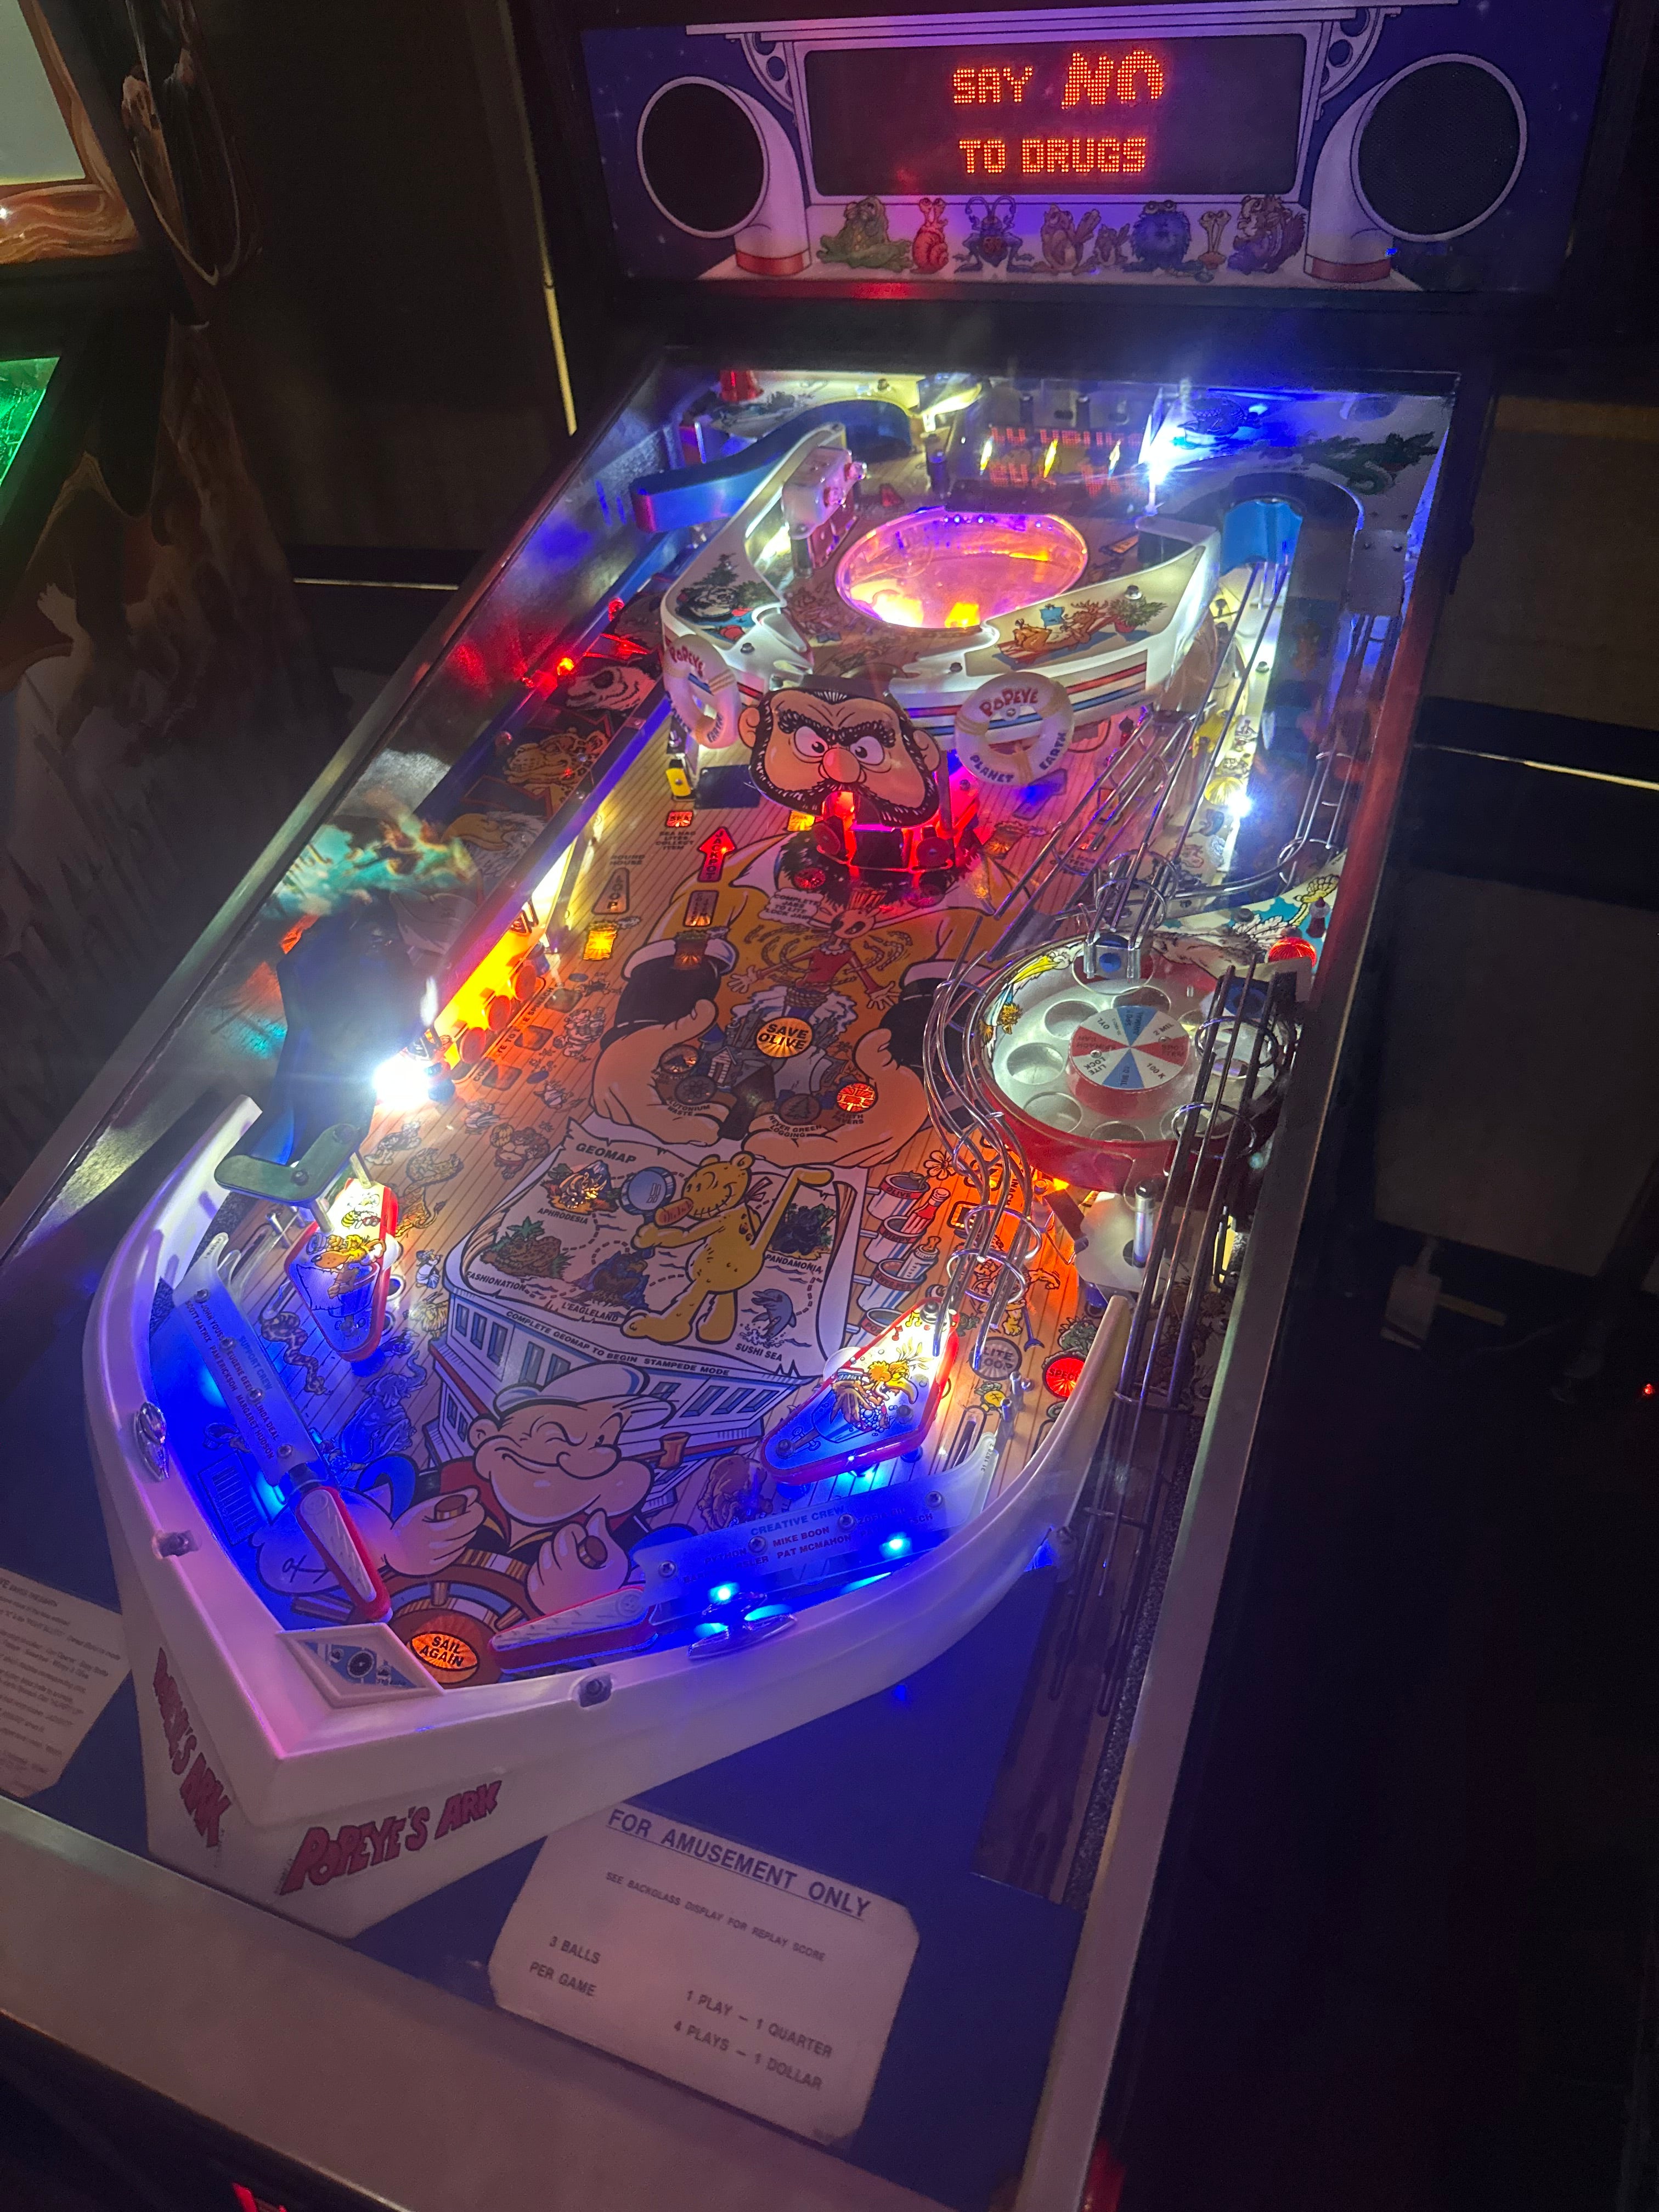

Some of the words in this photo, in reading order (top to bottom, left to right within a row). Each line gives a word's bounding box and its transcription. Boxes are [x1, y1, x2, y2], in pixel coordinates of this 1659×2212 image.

[953, 66, 1033, 104] SAY
[1061, 50, 1164, 110] NO
[959, 138, 1006, 173] TO
[1022, 137, 1147, 173] DRUGS
[669, 646, 704, 677] POPEYE
[979, 687, 1038, 716] POPEYE
[969, 754, 1014, 783] PLANET
[1039, 732, 1066, 770] EARTH
[706, 831, 724, 879] JACKPOT
[774, 894, 821, 905] COMPLETE
[766, 1023, 809, 1039] SAVE
[1097, 1018, 1110, 1030] OYL
[505, 1032, 516, 1043] TO
[758, 1034, 807, 1050] OLIVE
[1084, 1057, 1106, 1070] LOCK
[1088, 1064, 1107, 1075] LITE
[1147, 1063, 1160, 1074] 100
[667, 1107, 693, 1116] WASTE
[769, 1115, 791, 1131] NEVER
[792, 1125, 822, 1133] GREEN
[770, 1125, 805, 1138] LOGGING
[575, 1142, 637, 1164] GEOMAP
[885, 1186, 912, 1199] OLIVE
[537, 1207, 589, 1224] APHRODESIA
[764, 1254, 822, 1274] PANDAMONIA
[466, 1271, 527, 1291] FASHIONATION
[561, 1302, 619, 1323] L'EAGLELAND
[506, 1310, 551, 1335] COMPLETE
[553, 1331, 590, 1350] GEOMAP
[592, 1347, 605, 1356] TO
[606, 1350, 638, 1363] BEGIN
[644, 1357, 697, 1372] STAMPEDE
[699, 1364, 730, 1376] MODE
[735, 1343, 764, 1356] SUSHI
[764, 1351, 782, 1361] SEA
[983, 1347, 1013, 1361] LITE
[200, 1304, 214, 1322] JOHN
[211, 1320, 225, 1341] YOUSS
[227, 1351, 245, 1377] EUGENE
[255, 1400, 270, 1422] LINDA
[266, 1420, 280, 1441] DEAL
[240, 1335, 259, 1369] SUPPORT
[257, 1367, 273, 1391] CREW
[984, 1359, 1013, 1369] OOP
[185, 1300, 199, 1319] SCOTT
[195, 1318, 212, 1343] MATRIX
[217, 1358, 238, 1392] ERICKSON
[236, 1394, 259, 1429] MARGARET
[255, 1428, 274, 1459] HUDSON
[1048, 1368, 1079, 1381] SPECI
[750, 1515, 809, 1536] CREATIVE
[811, 1505, 845, 1521] CREW
[772, 1534, 799, 1548] MIKE
[800, 1526, 831, 1541] BOON
[777, 1548, 798, 1560] PAT
[799, 1534, 852, 1553] MCMAHON
[419, 1645, 464, 1667] AGAIN
[431, 1635, 461, 1655] SAIL
[279, 1806, 430, 1895] POPEYE'S
[434, 1780, 503, 1840] ARK
[608, 1809, 653, 1838] FOR
[661, 1828, 798, 1890] AMUSEMENT
[808, 1881, 871, 1918] ONLY
[606, 1871, 624, 1884] SEE
[627, 1880, 681, 1906] BACKGLASS
[684, 1901, 725, 1921] DISPLAY
[727, 1917, 748, 1931] FOR
[752, 1927, 789, 1947] REPLAY
[793, 1943, 826, 1962] SCORE
[549, 1935, 558, 1947] 3
[561, 1939, 601, 1965] BALLS
[529, 1961, 555, 1980] PER
[558, 1973, 597, 1997] GAME
[686, 1990, 693, 2001] 1
[697, 1994, 733, 2016] PLAY
[756, 2018, 764, 2030] 1
[768, 2022, 833, 2058] QUARTER
[673, 2020, 682, 2032] 4
[687, 2024, 730, 2051] PLAYS
[754, 2052, 762, 2064] 1
[765, 2057, 823, 2091] DOLLAR
